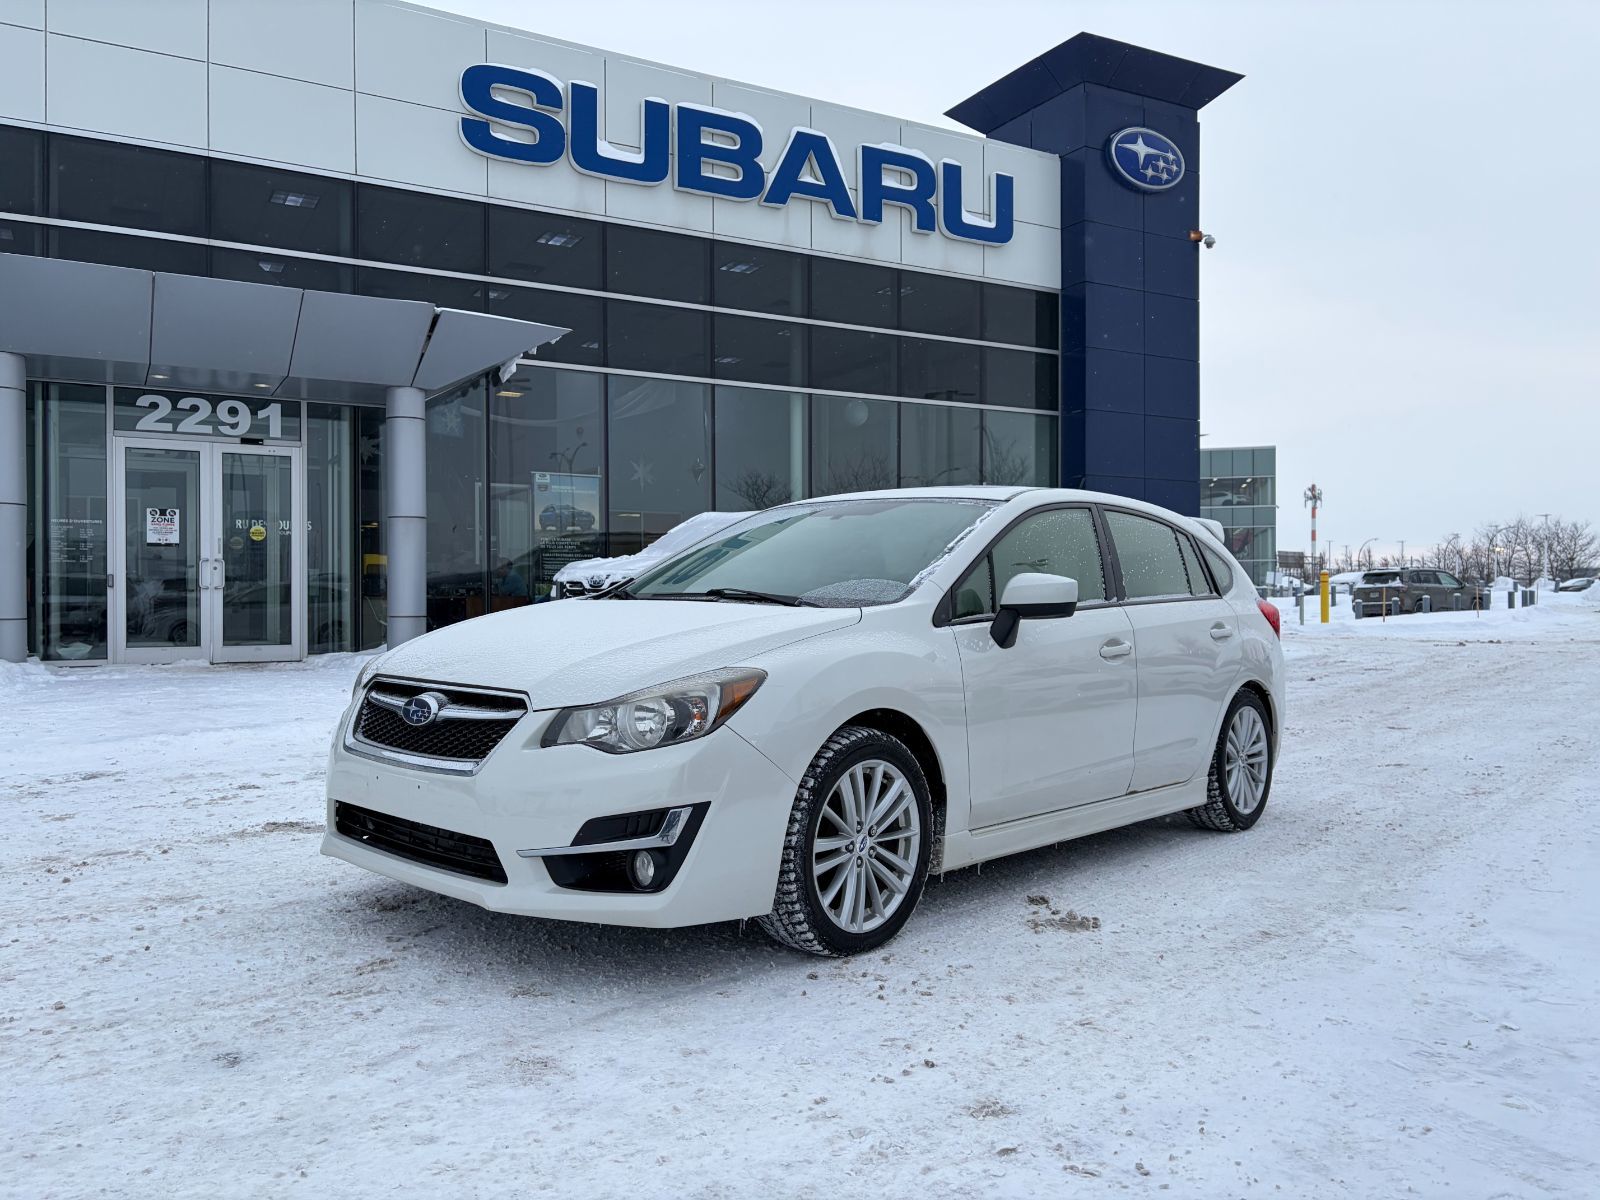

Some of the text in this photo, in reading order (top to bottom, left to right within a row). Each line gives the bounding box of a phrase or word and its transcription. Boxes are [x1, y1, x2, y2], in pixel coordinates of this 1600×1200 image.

[459, 62, 1015, 247] SUBARU
[135, 394, 282, 438] 2291
[150, 516, 176, 524] ZONE
